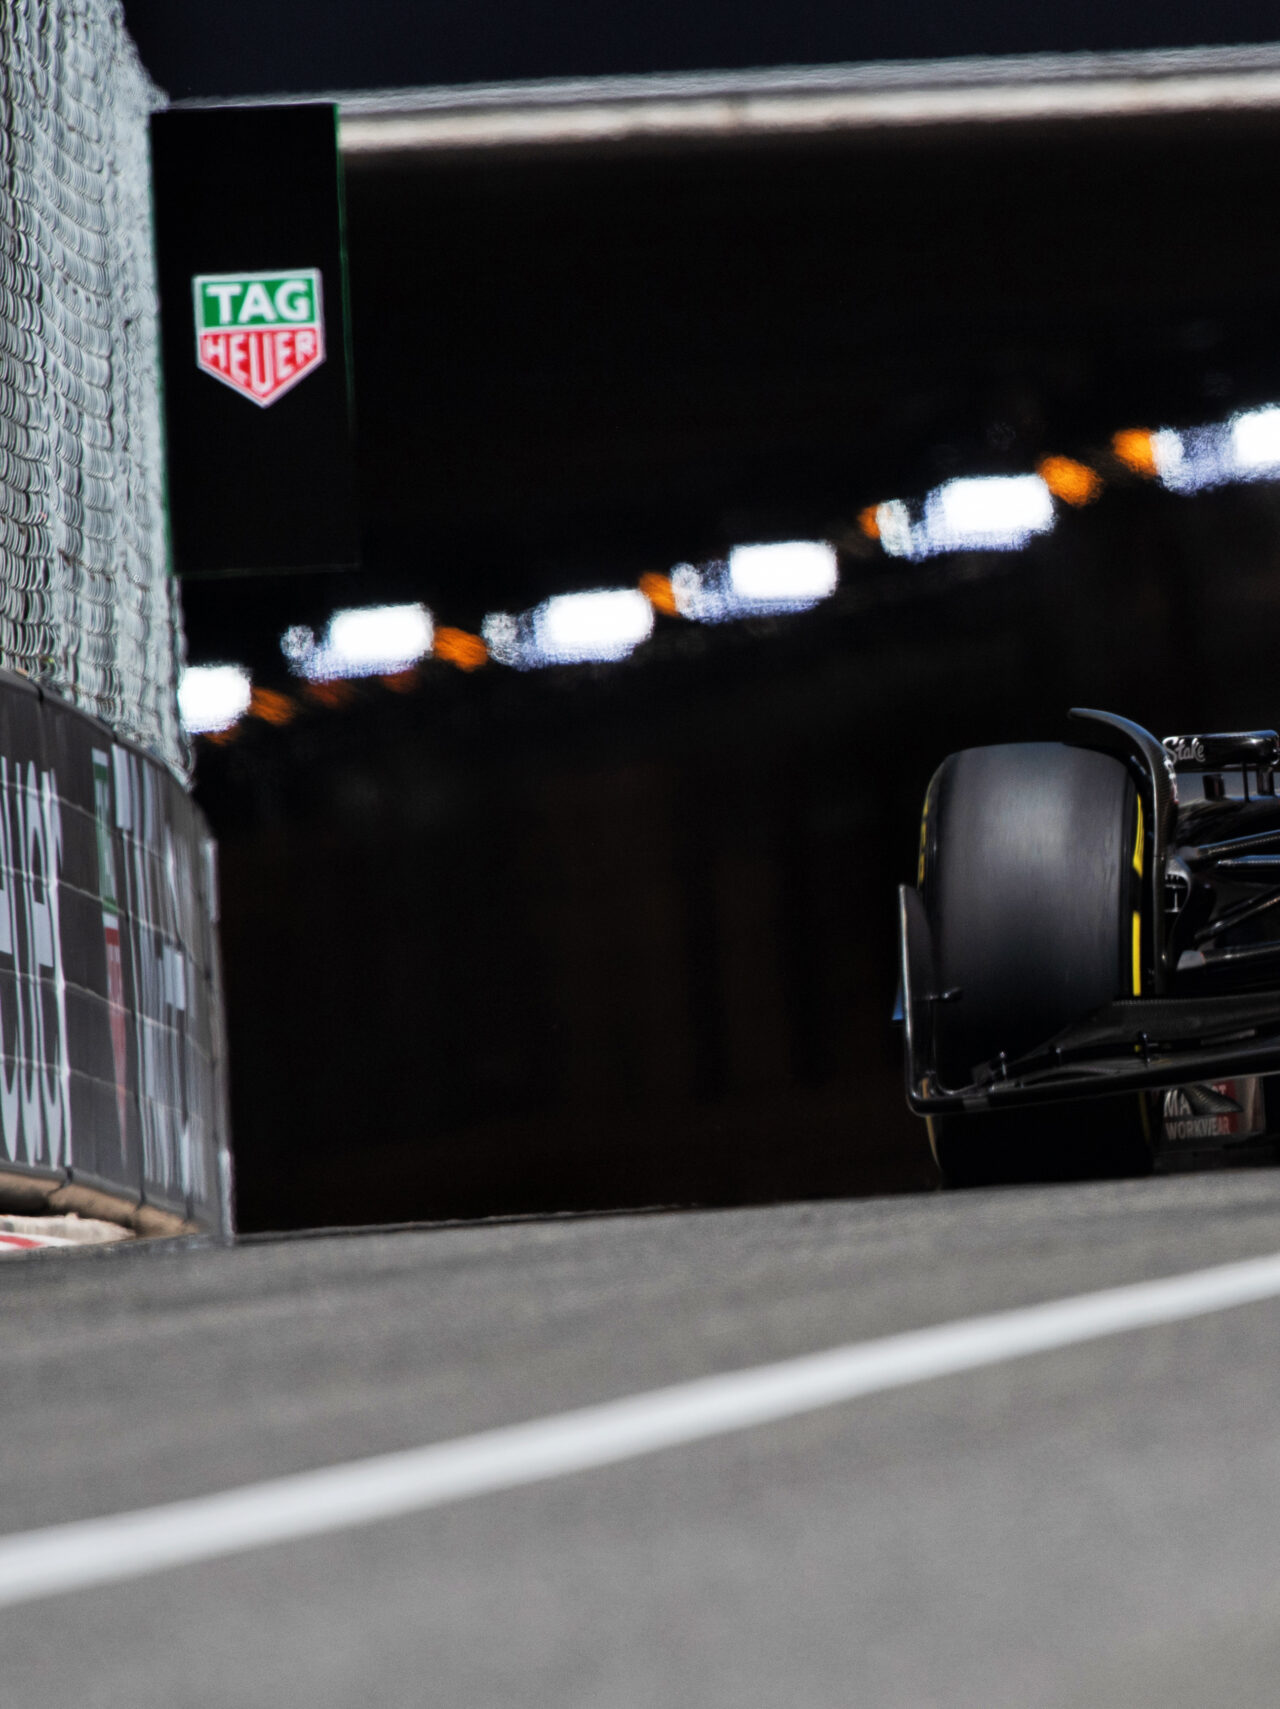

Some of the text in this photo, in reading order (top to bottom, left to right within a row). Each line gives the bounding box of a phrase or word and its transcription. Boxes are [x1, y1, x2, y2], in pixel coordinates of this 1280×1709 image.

[206, 279, 311, 325] TAG
[204, 330, 316, 393] HEUER
[1162, 736, 1206, 763] Stake
